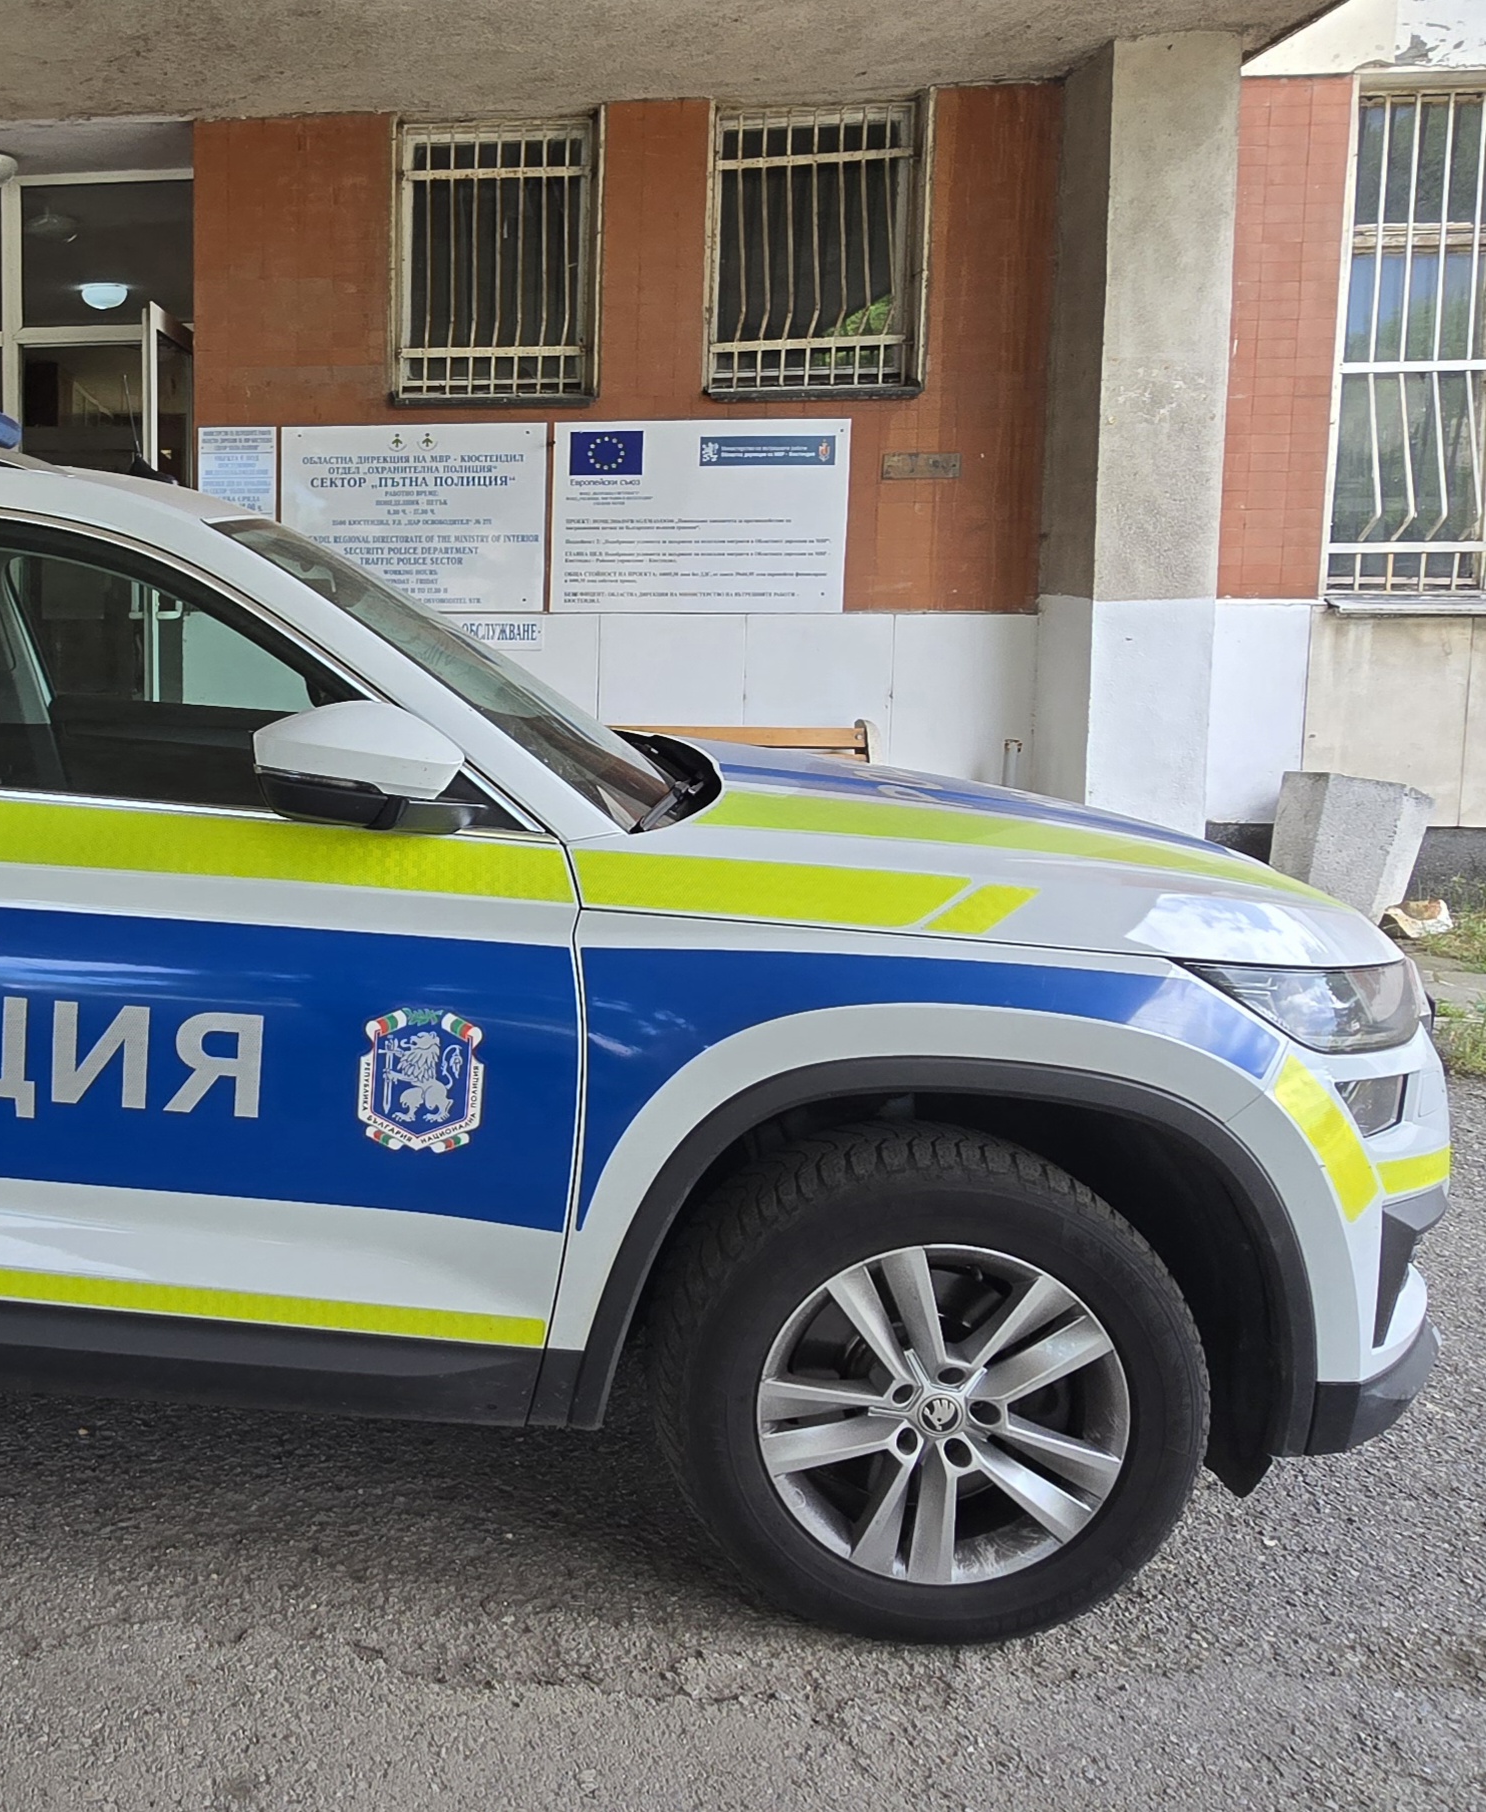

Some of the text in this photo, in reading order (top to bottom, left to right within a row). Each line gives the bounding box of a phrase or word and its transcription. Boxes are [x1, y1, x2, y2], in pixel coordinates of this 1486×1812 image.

[302, 456, 354, 465] ОБЛАСТНА
[355, 455, 410, 465] ДИРЕКЦИЯ
[412, 455, 427, 463] НА
[429, 454, 451, 463] МВР
[460, 454, 524, 463] КЮСТЕНДИЛ
[328, 466, 361, 475] ОТДЕЛ
[310, 477, 367, 488] СЕКТОР
[333, 535, 371, 544] REGIONAL
[372, 535, 424, 544] DIRECTORATE
[425, 535, 435, 543] OF
[437, 535, 452, 543] THE
[454, 534, 490, 543] MINISTRY
[491, 534, 503, 542] OF
[503, 534, 539, 543] INTERIOR
[343, 546, 479, 555] SECURITY POLICE DEPARTMENT
[359, 557, 464, 566] TRAFFIC POLICE SECTOR
[361, 1061, 371, 1112] РЕПУБЛИКА
[470, 1065, 479, 1109] ПОЛИЦИЯ
[366, 1114, 413, 1143] БЪЛГАРИЯ
[420, 1112, 476, 1144] НАЦИОНАЛНА
